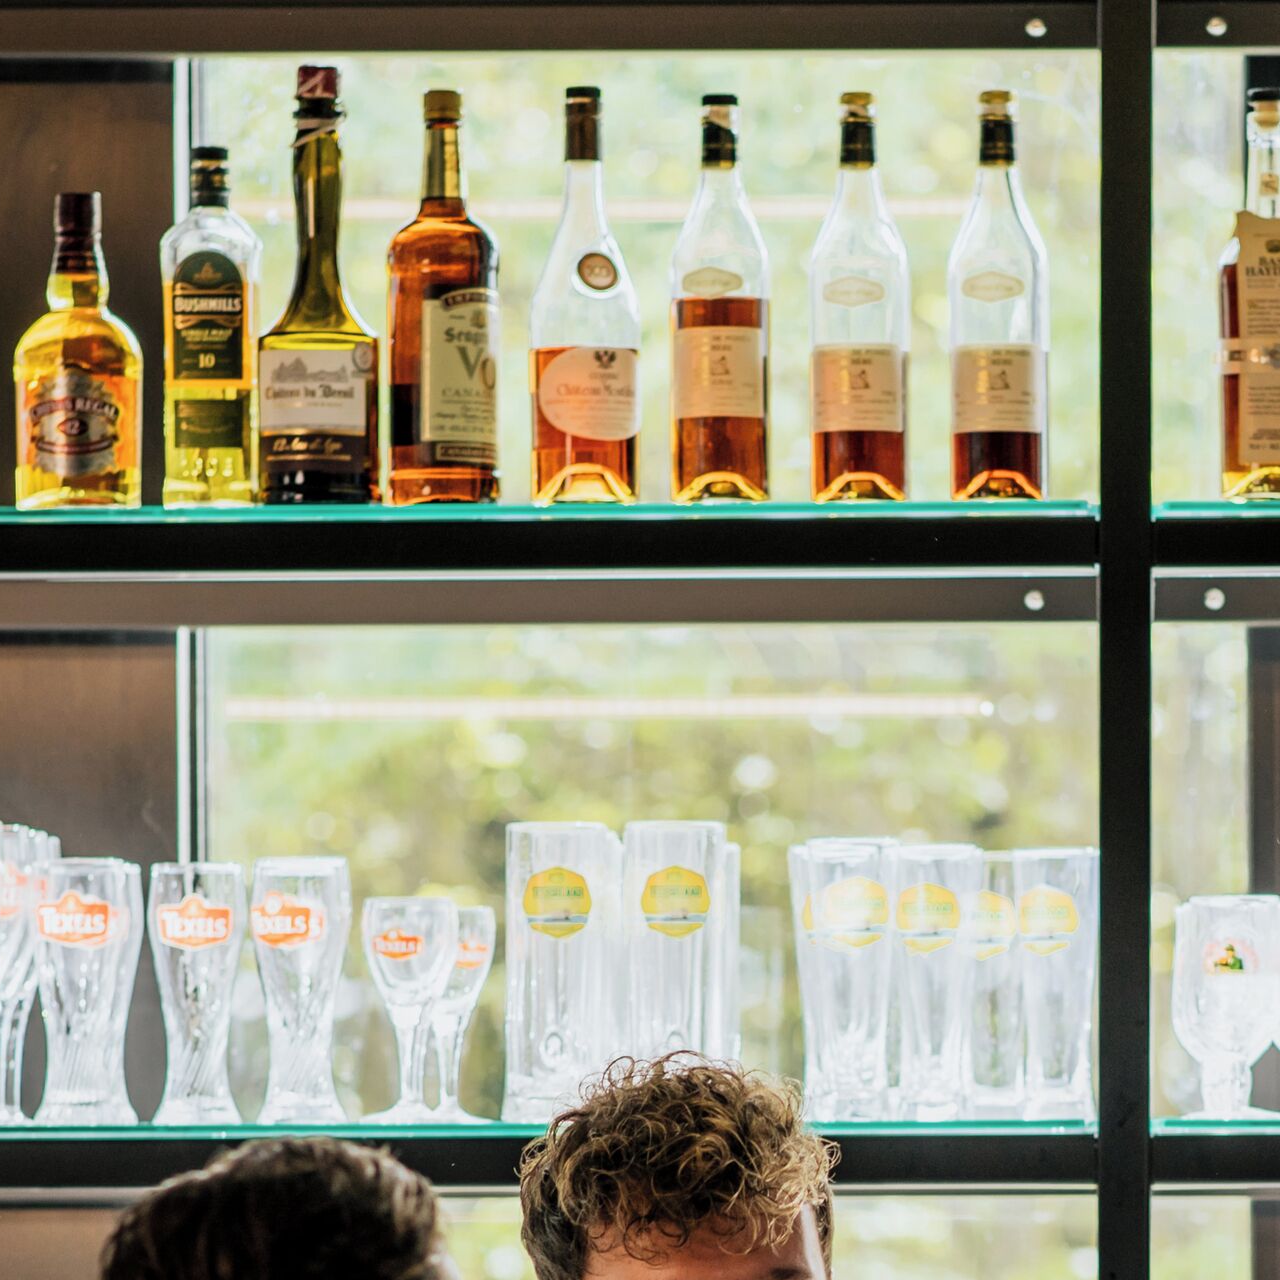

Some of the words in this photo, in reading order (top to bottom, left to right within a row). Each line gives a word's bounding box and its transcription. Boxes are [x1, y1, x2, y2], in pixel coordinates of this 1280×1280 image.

[174, 297, 242, 313] BUSHMILLS
[198, 353, 216, 368] 10
[39, 905, 108, 934] TEXELS
[161, 911, 227, 937] TEXELS
